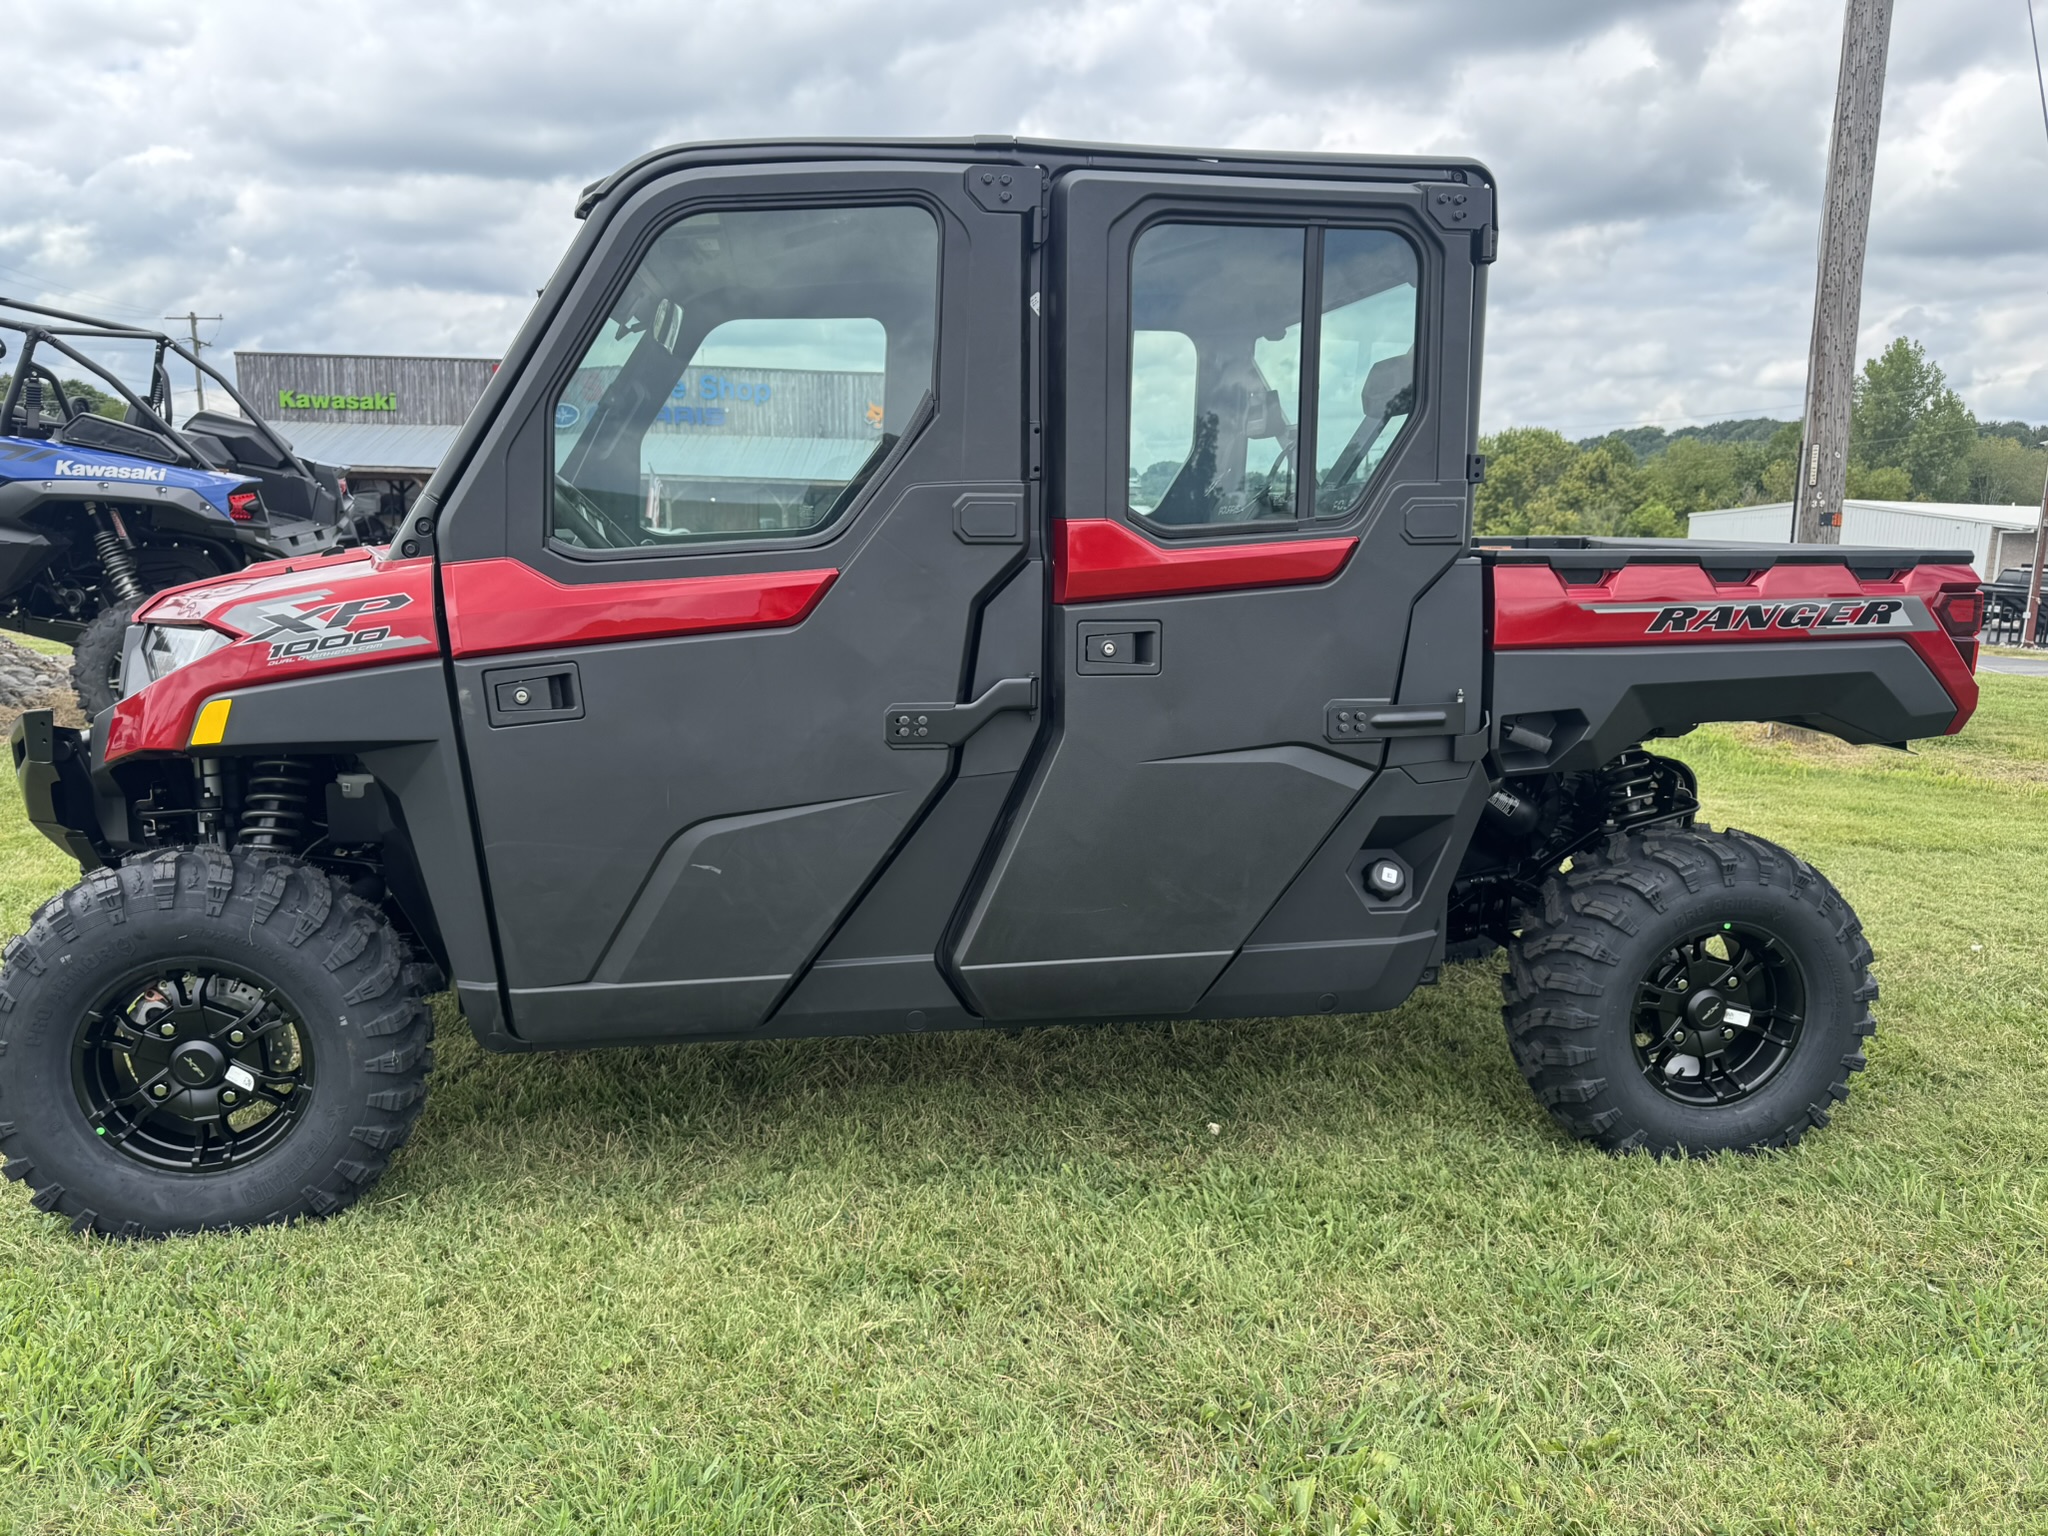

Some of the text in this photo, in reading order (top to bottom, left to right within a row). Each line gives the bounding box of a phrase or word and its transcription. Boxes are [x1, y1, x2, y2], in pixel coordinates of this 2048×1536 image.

[278, 389, 397, 411] Kawasaki
[700, 374, 772, 407] Shop
[655, 405, 725, 426] ARIS
[55, 460, 167, 481] Kawasaki
[232, 592, 414, 647] XP
[1645, 600, 1903, 633] RANGER
[267, 625, 392, 660] 1000
[267, 643, 384, 667] DUAL OVERHEAD CAM
